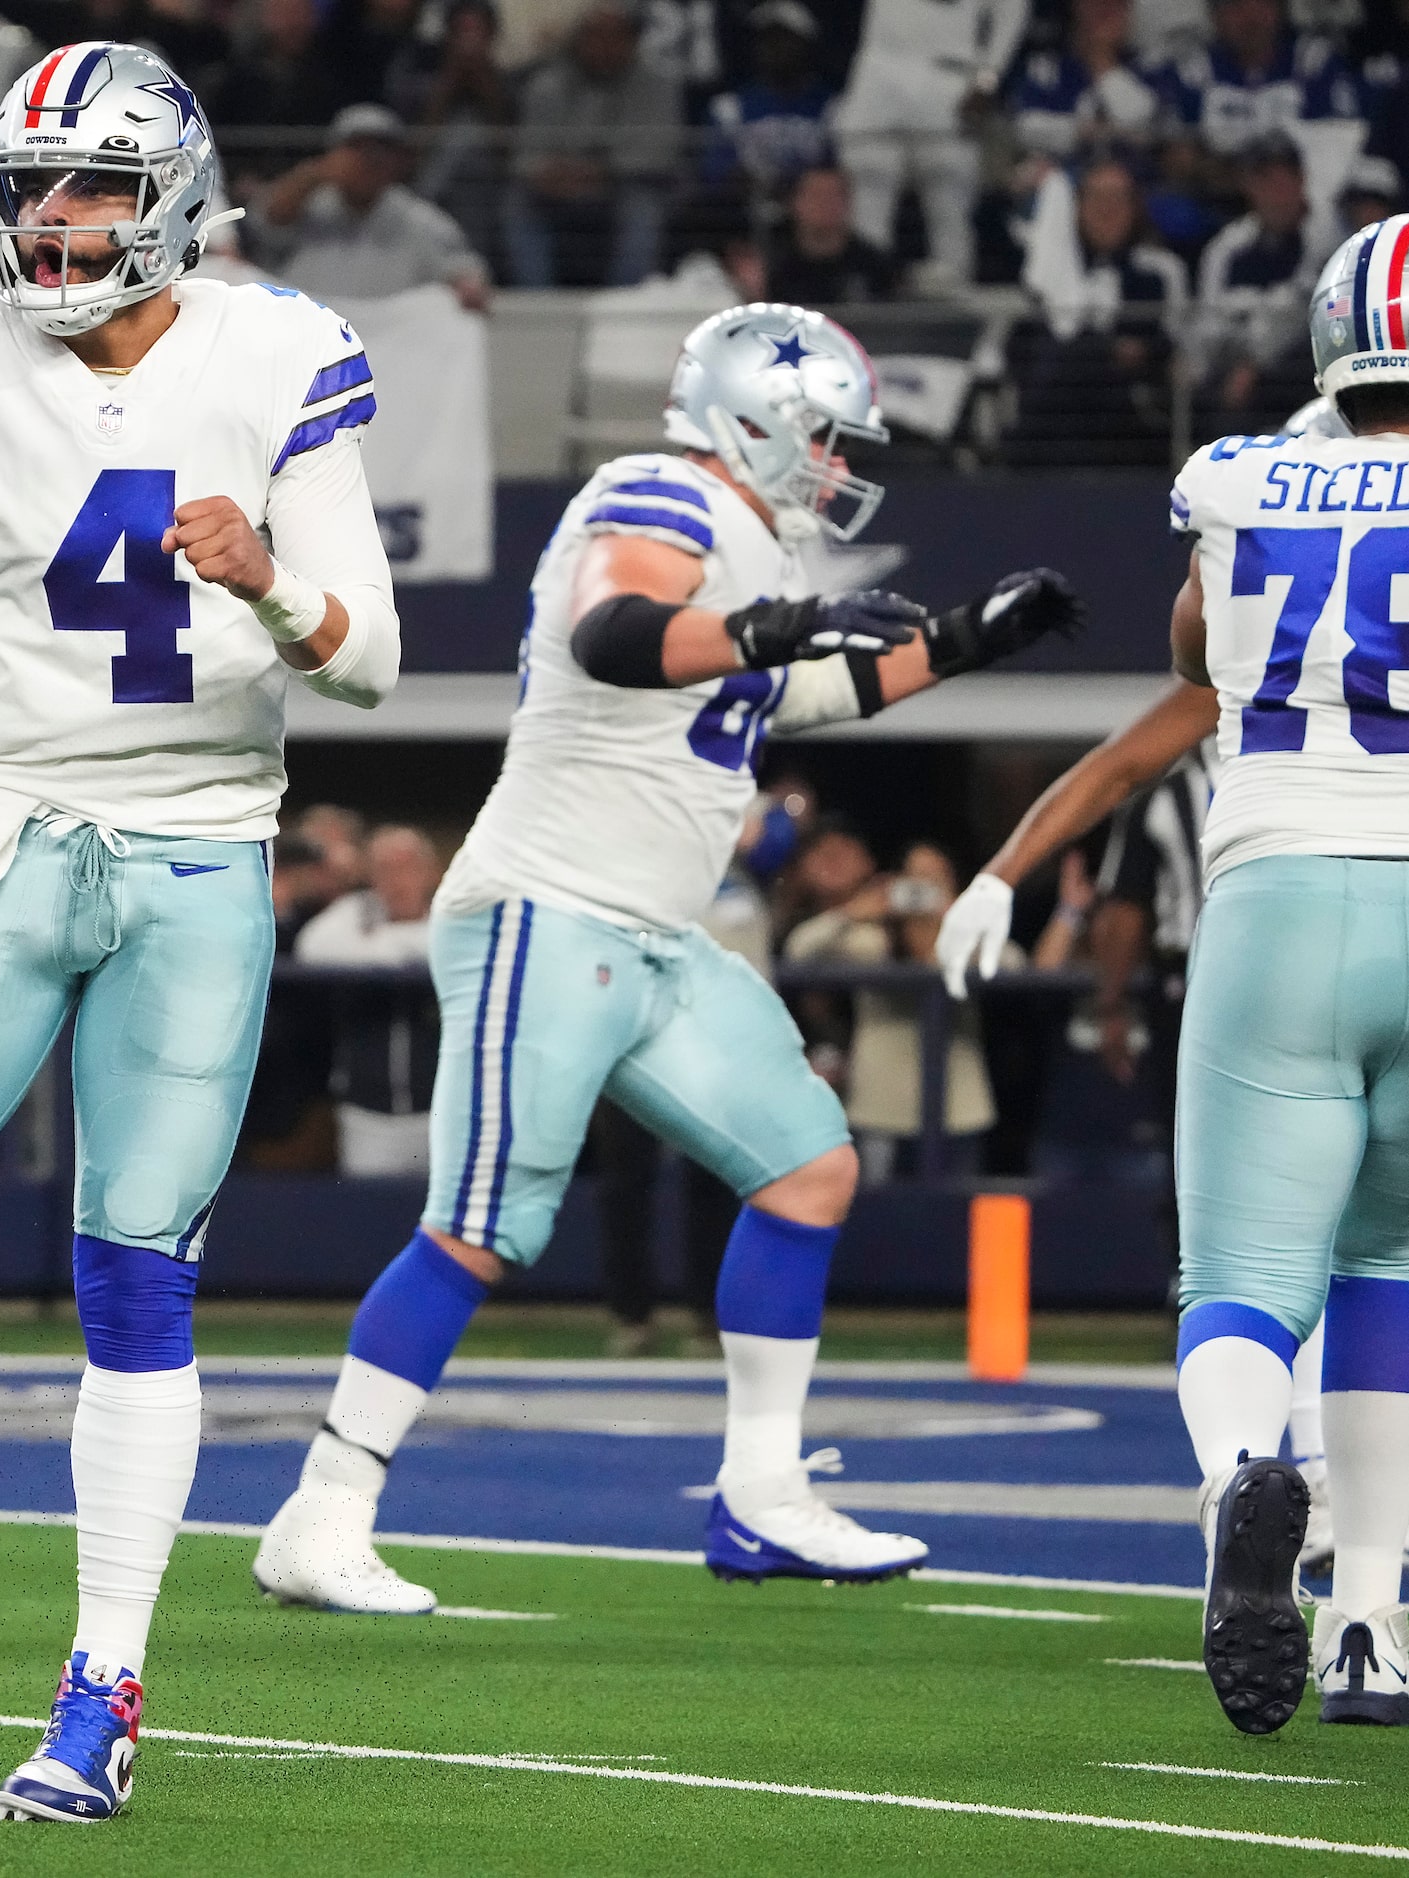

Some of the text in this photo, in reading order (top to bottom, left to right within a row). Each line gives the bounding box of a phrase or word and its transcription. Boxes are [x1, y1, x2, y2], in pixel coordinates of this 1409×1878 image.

[25, 136, 67, 145] COWBOYS
[1352, 356, 1409, 371] COWBOY
[43, 468, 194, 704] 4
